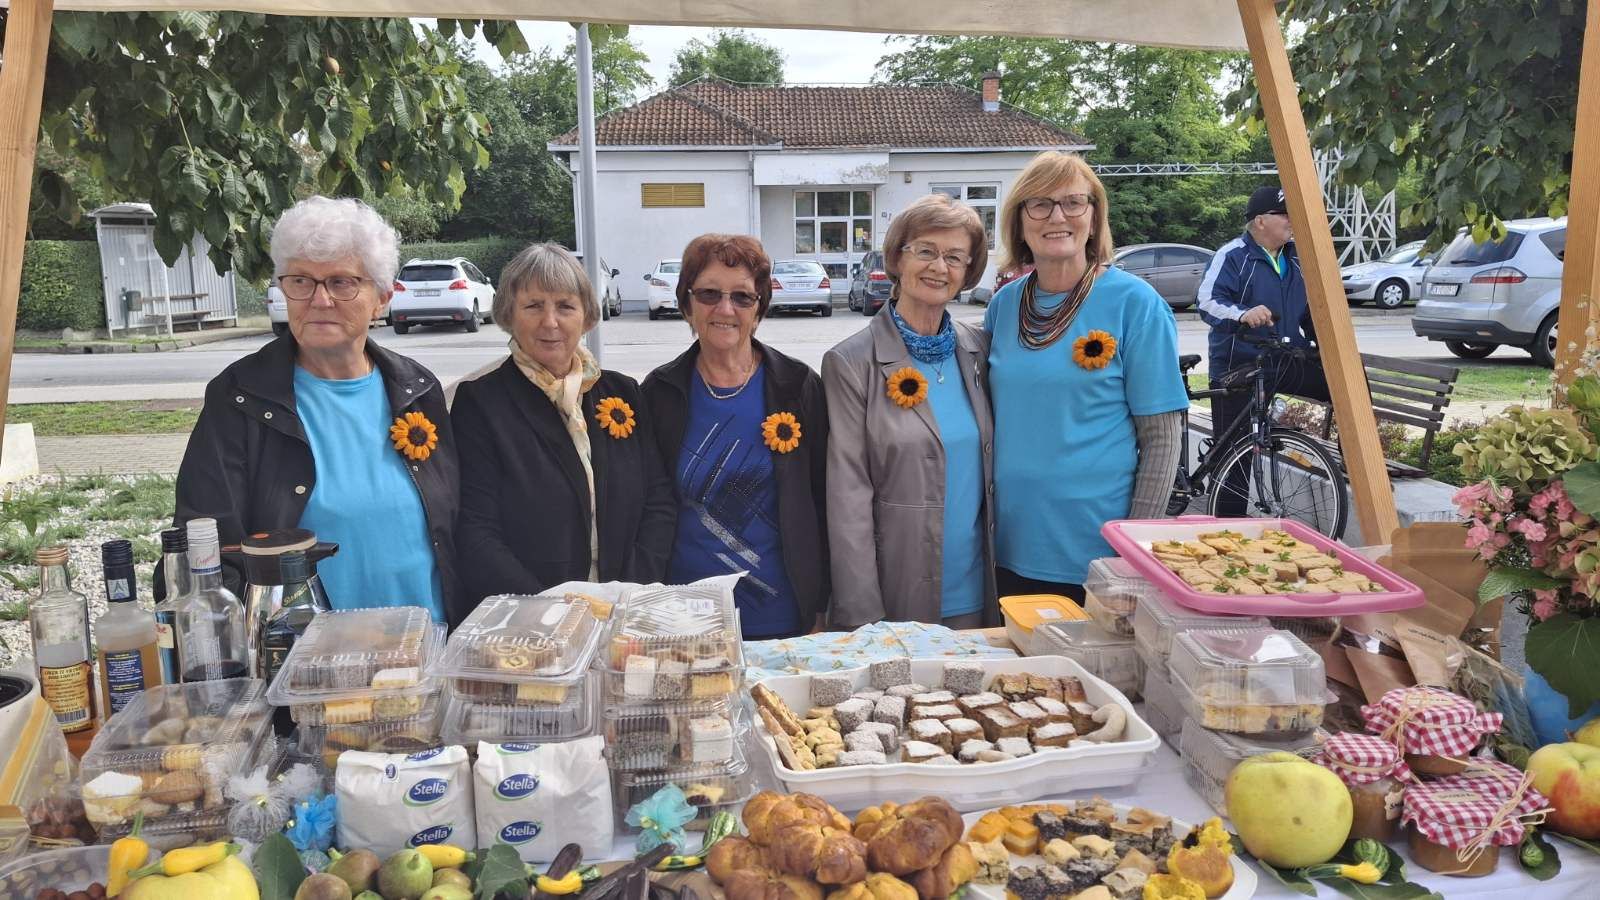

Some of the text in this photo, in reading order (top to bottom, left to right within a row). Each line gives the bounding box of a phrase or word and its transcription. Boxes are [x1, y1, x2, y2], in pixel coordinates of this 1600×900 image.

[414, 781, 446, 796] Stella
[503, 777, 535, 791] Stella
[415, 829, 448, 843] Stella
[505, 825, 536, 837] Stella
